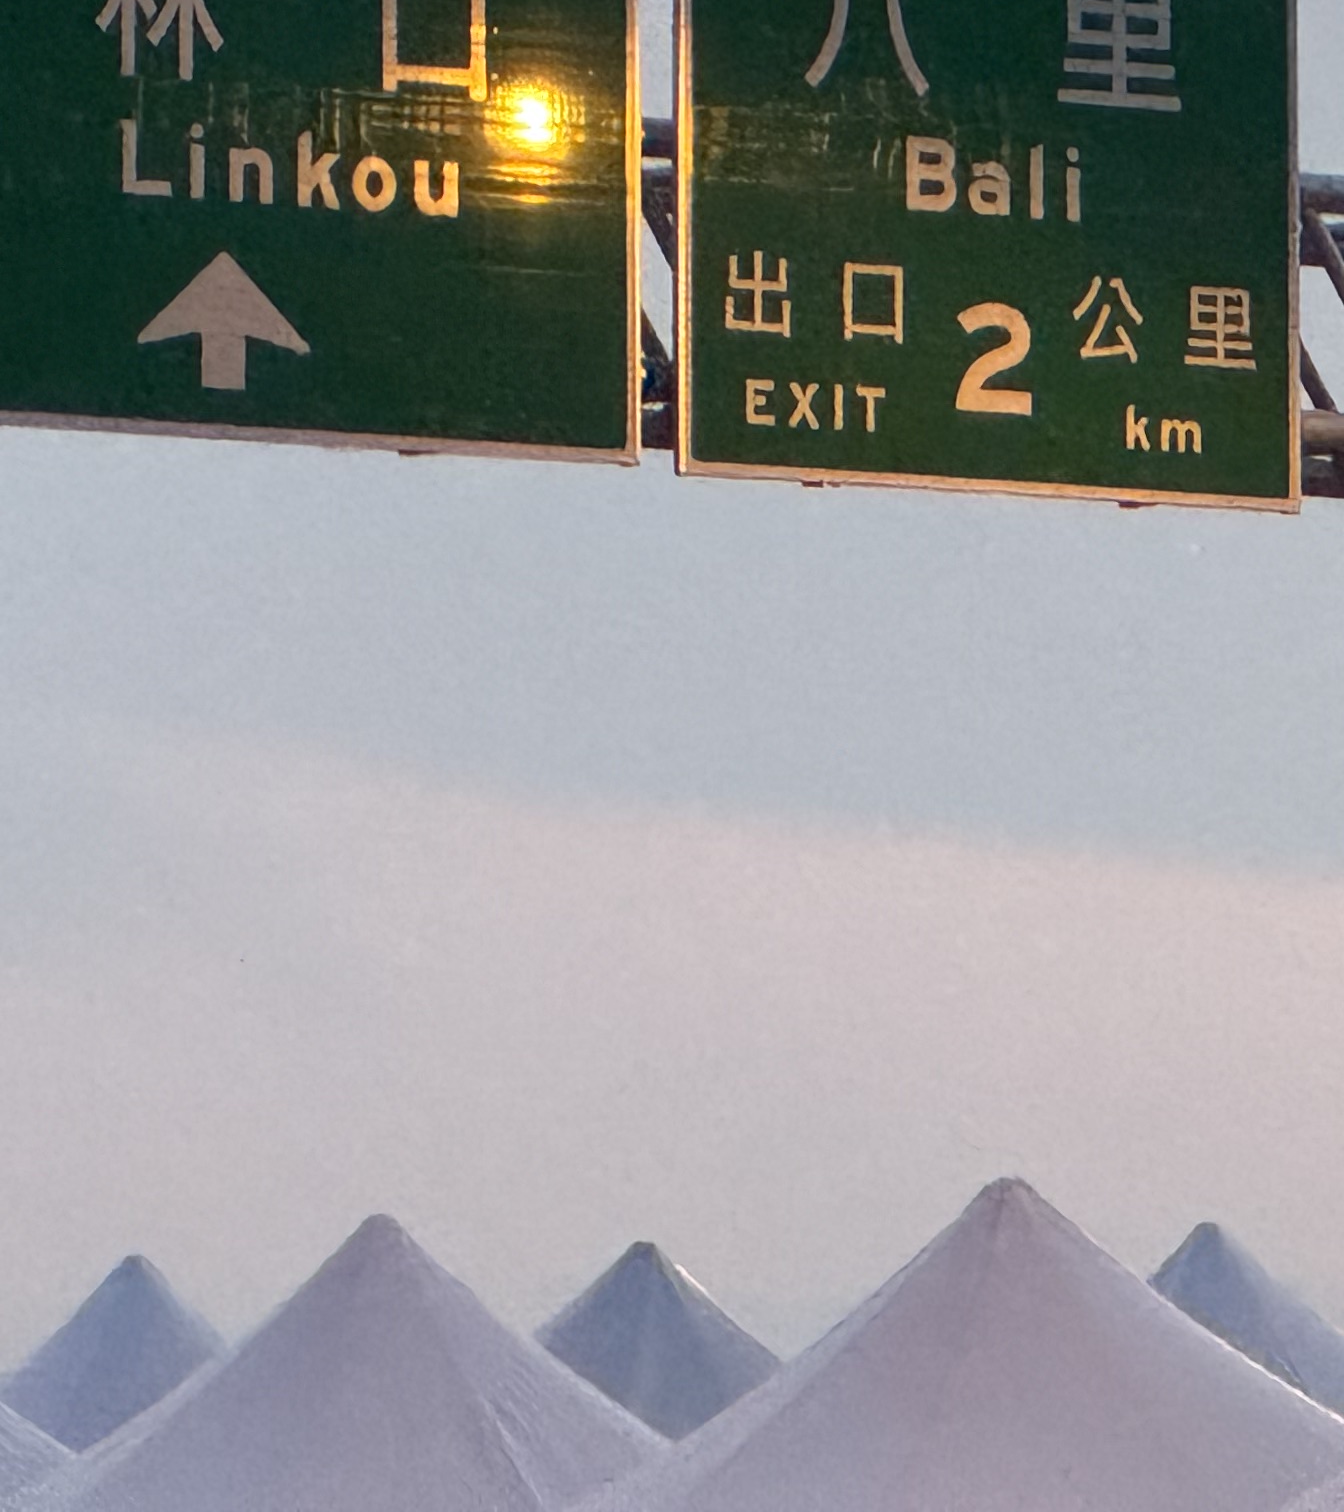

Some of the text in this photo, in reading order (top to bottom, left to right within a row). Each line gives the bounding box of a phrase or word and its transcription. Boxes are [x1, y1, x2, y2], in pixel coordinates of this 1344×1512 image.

[120, 119, 460, 218] Linkou
[906, 135, 1082, 222] Bali
[725, 251, 1257, 416] 出口 2 公里
[745, 379, 886, 432] EXIT
[1126, 405, 1203, 454] km
